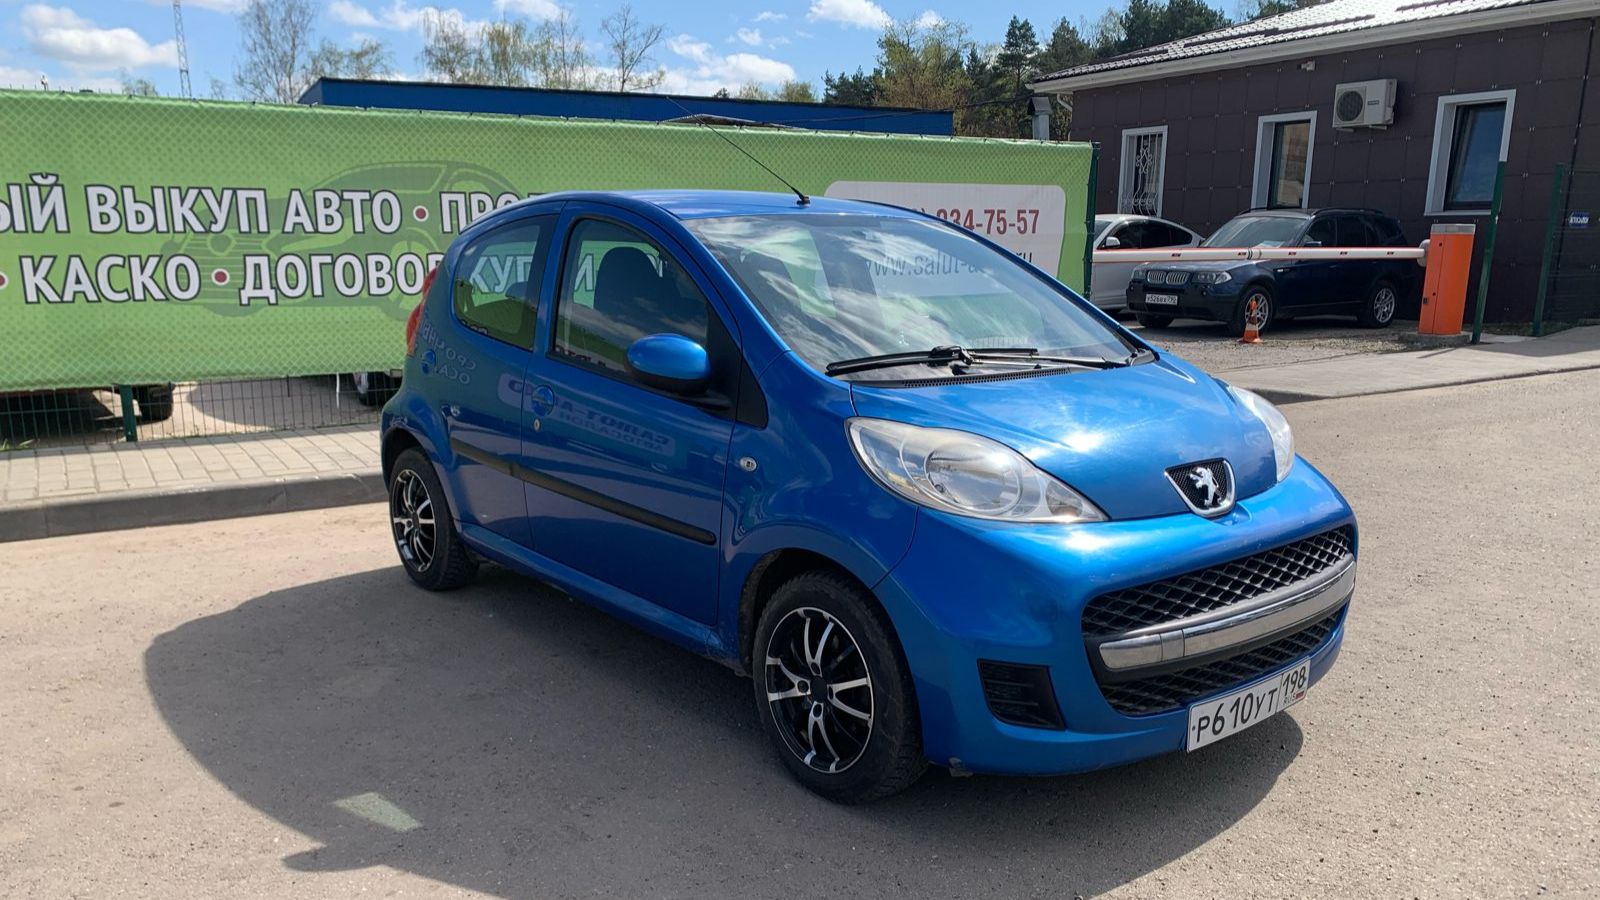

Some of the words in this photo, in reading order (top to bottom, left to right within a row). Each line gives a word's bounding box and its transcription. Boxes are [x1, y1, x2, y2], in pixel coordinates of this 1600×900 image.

[84, 184, 270, 236] ВЫКУП
[283, 189, 403, 235] АВТО
[18, 254, 200, 304] КАСКО
[1196, 688, 1278, 743] Р610УТ
[1283, 666, 1306, 696] 198
